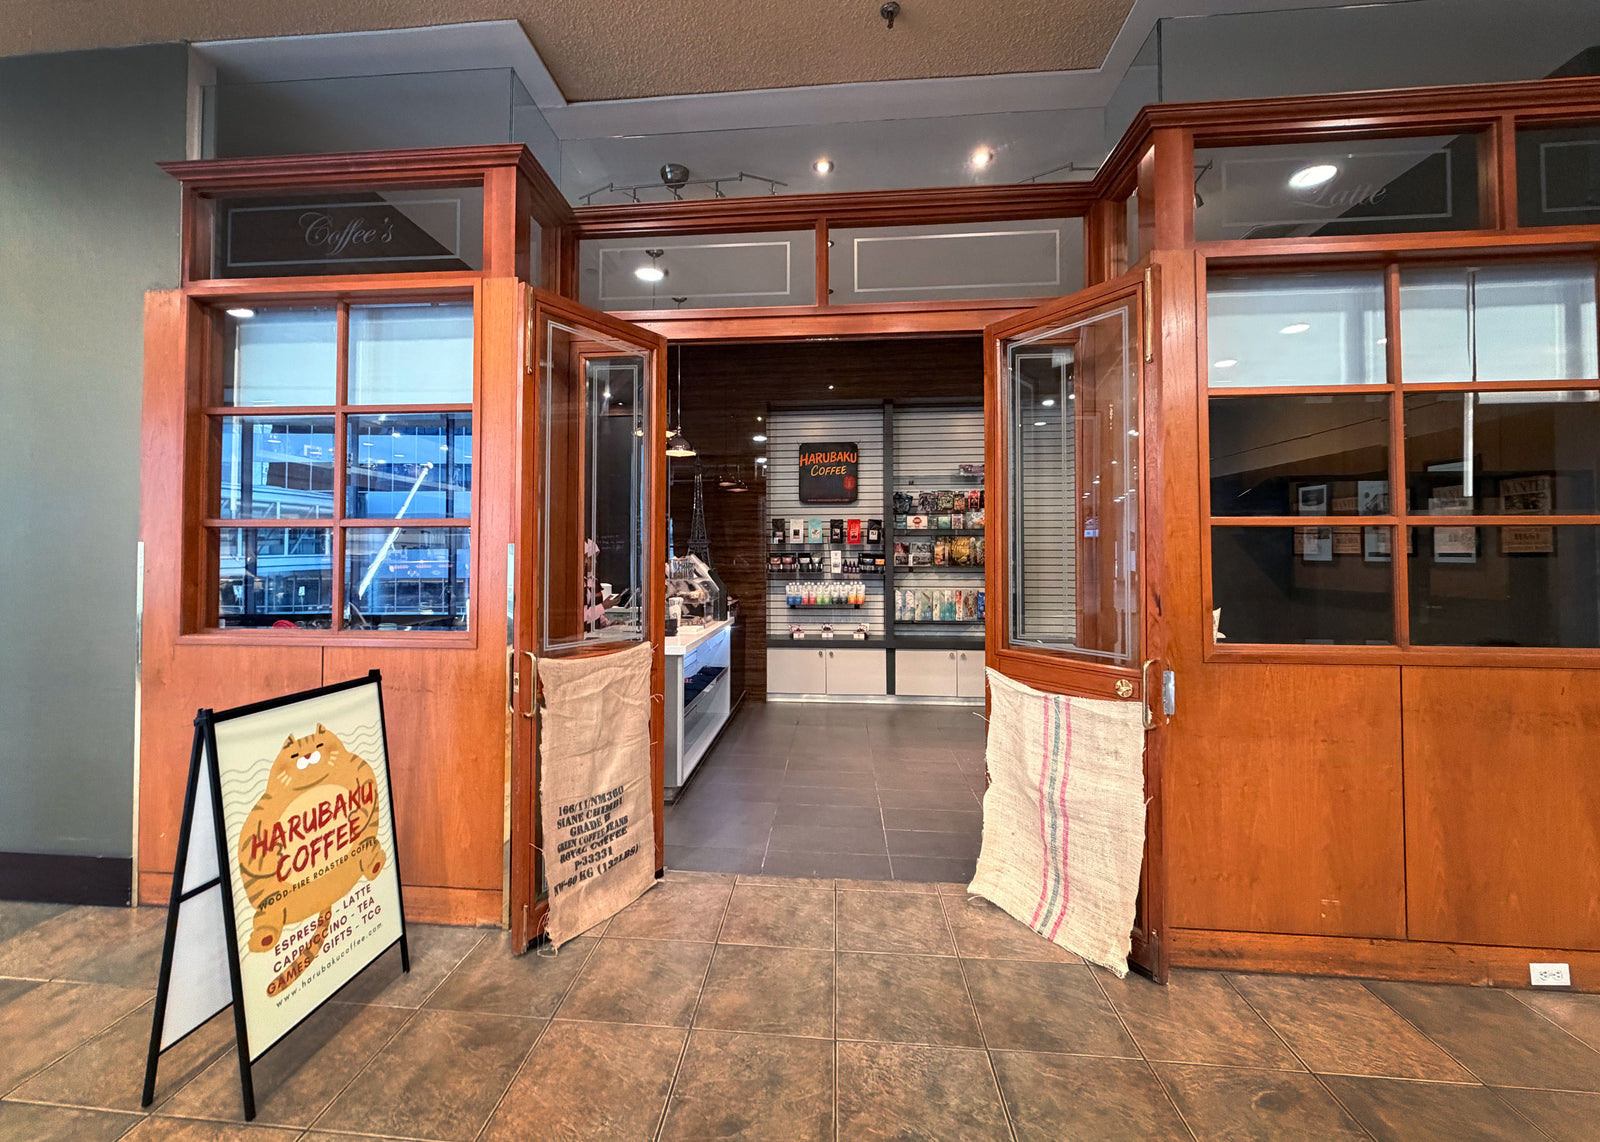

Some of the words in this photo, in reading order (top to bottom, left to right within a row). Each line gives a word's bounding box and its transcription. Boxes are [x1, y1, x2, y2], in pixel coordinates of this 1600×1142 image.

[298, 211, 394, 256] Coffee's
[799, 451, 857, 467] HARUBAKU
[810, 465, 847, 477] COFFEE
[251, 782, 373, 859] HARUBAKU
[557, 812, 584, 829] SIANE
[557, 838, 578, 853] GREEN
[579, 828, 605, 846] COFFEE
[570, 817, 603, 837] GRADE
[604, 812, 611, 823] B
[276, 817, 361, 882] COFFEE
[560, 845, 588, 864] ROYAL
[590, 825, 628, 850] COFFEE
[574, 846, 613, 871] P-33331
[257, 877, 310, 911] WOOD-FIRE
[313, 854, 349, 879] ROASTED
[351, 838, 377, 857] COFFEE
[273, 915, 348, 973] CAPPUCCINO
[357, 897, 375, 914] TEA
[274, 910, 332, 956] ESPRESSO
[343, 884, 372, 909] LATTE
[266, 956, 311, 995] GAMES
[322, 926, 353, 954] GIFTS
[362, 905, 382, 924] TCG
[276, 923, 383, 1008] www.harubakucoffee.com
